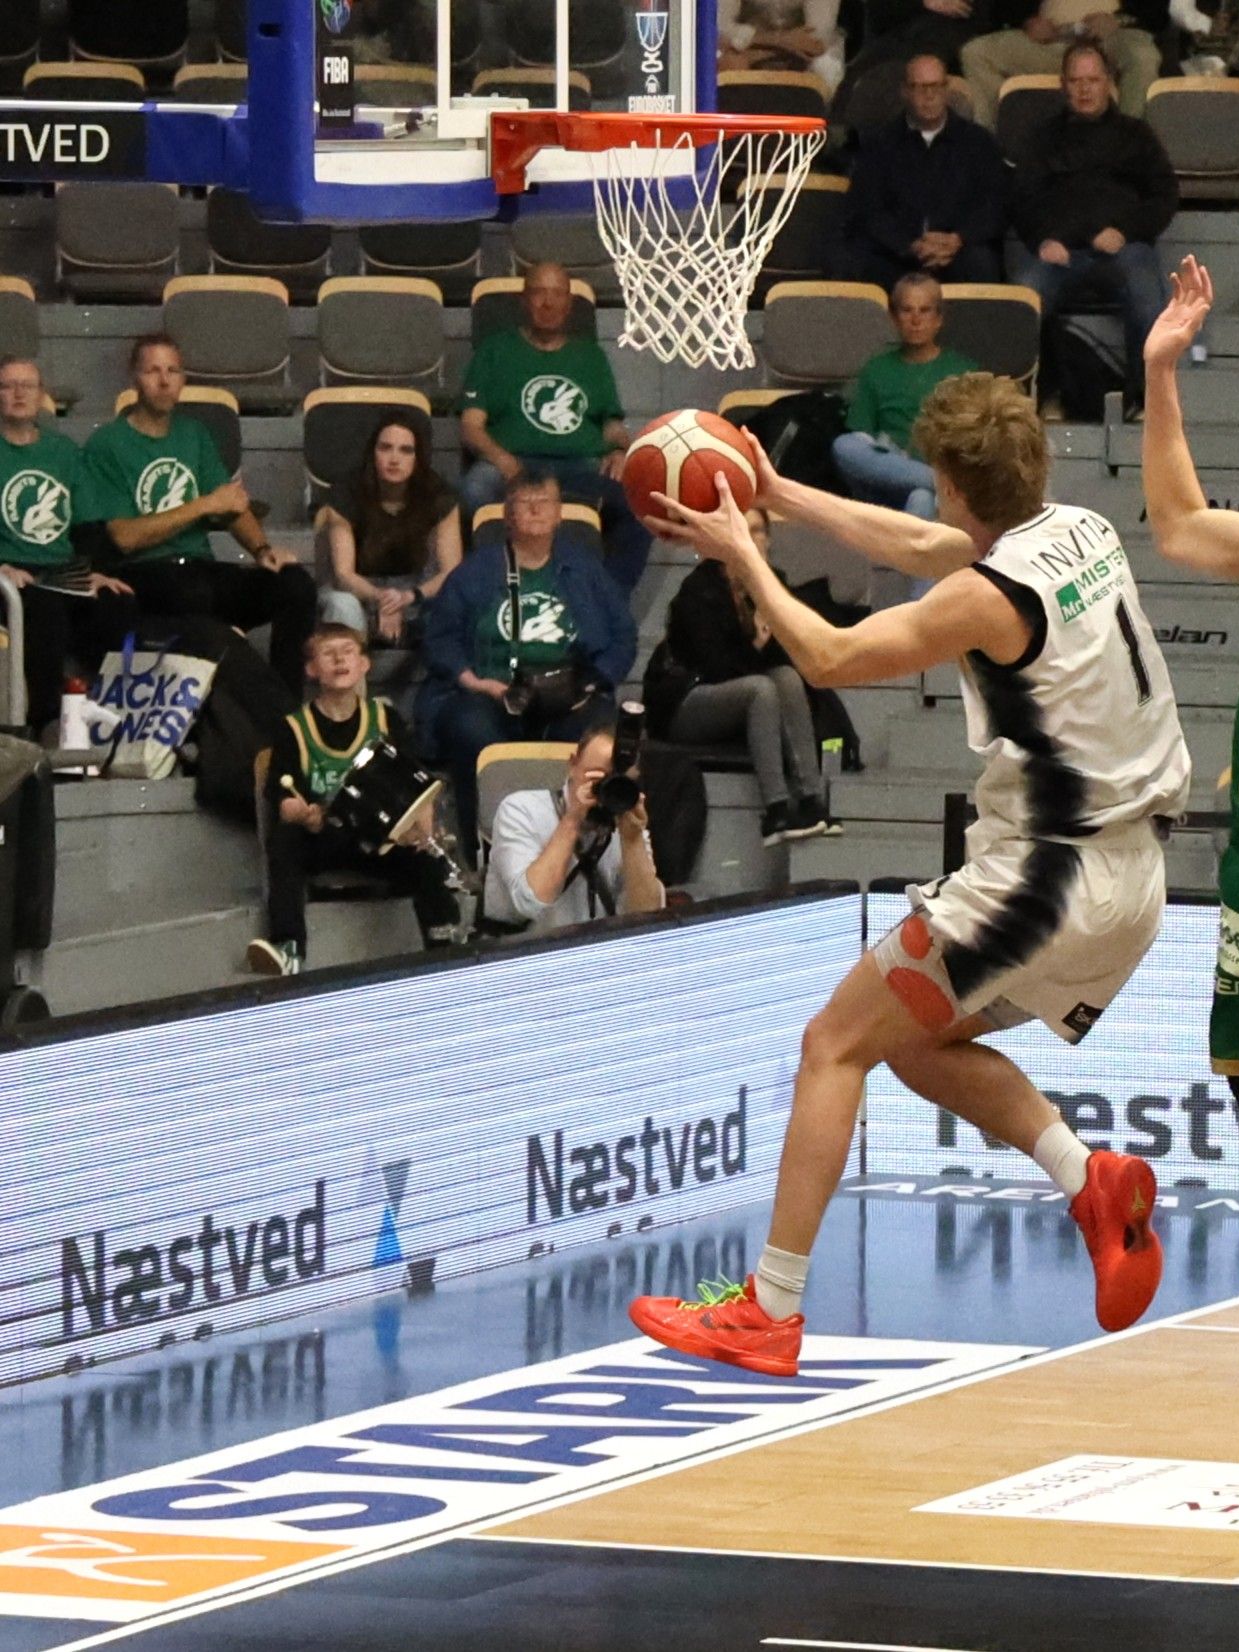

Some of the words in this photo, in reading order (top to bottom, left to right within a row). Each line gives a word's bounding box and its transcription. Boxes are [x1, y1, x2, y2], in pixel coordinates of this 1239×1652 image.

[323, 56, 349, 84] FIBA
[0, 123, 110, 162] TVED
[1030, 513, 1114, 582] INVITA
[1114, 593, 1154, 707] 1
[89, 709, 188, 746] ONES
[527, 1084, 748, 1225] Næstved
[845, 1182, 1179, 1208] AREA
[62, 1178, 326, 1338] Næstved
[90, 1346, 951, 1532] STARK
